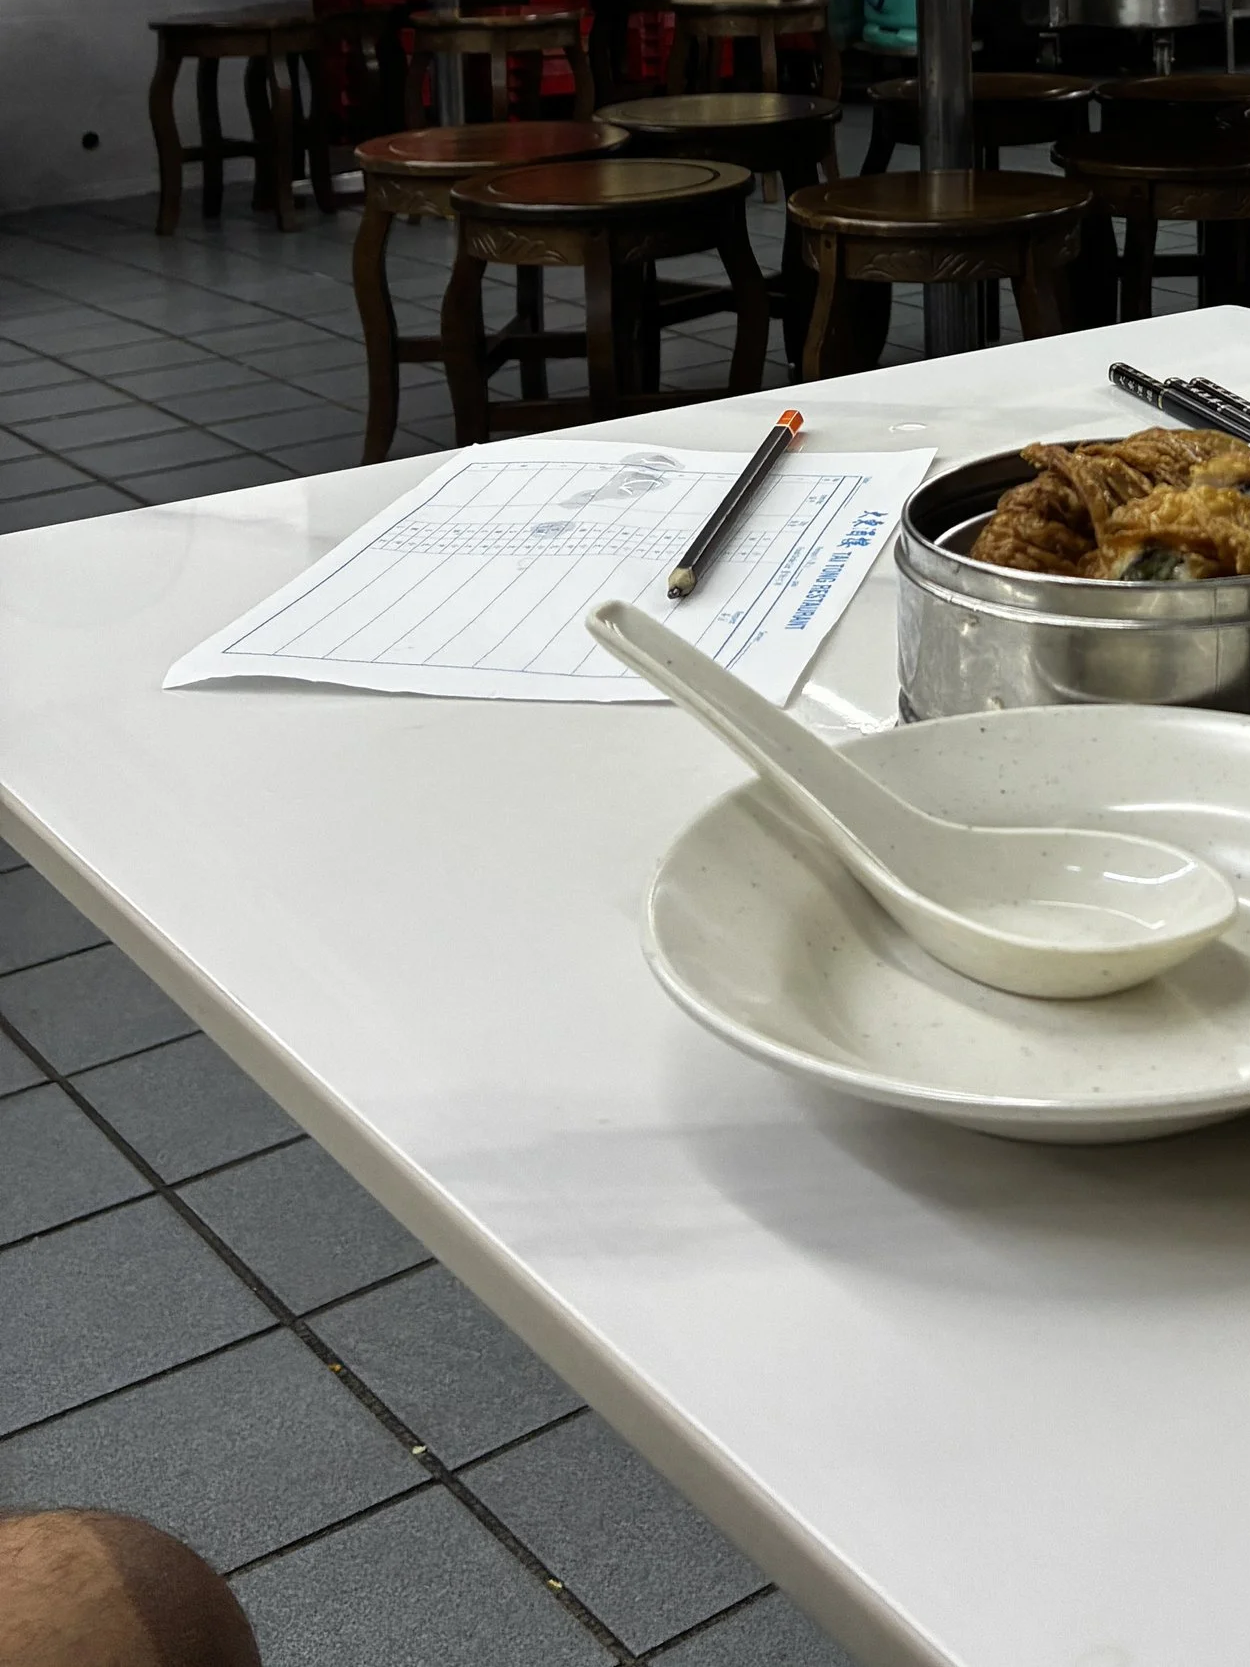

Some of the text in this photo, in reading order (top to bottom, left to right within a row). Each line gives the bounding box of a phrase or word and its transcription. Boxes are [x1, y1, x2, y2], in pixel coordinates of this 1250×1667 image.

[828, 551, 852, 563] TAI
[815, 563, 845, 583] TONG
[785, 584, 832, 630] RESTAURANT
